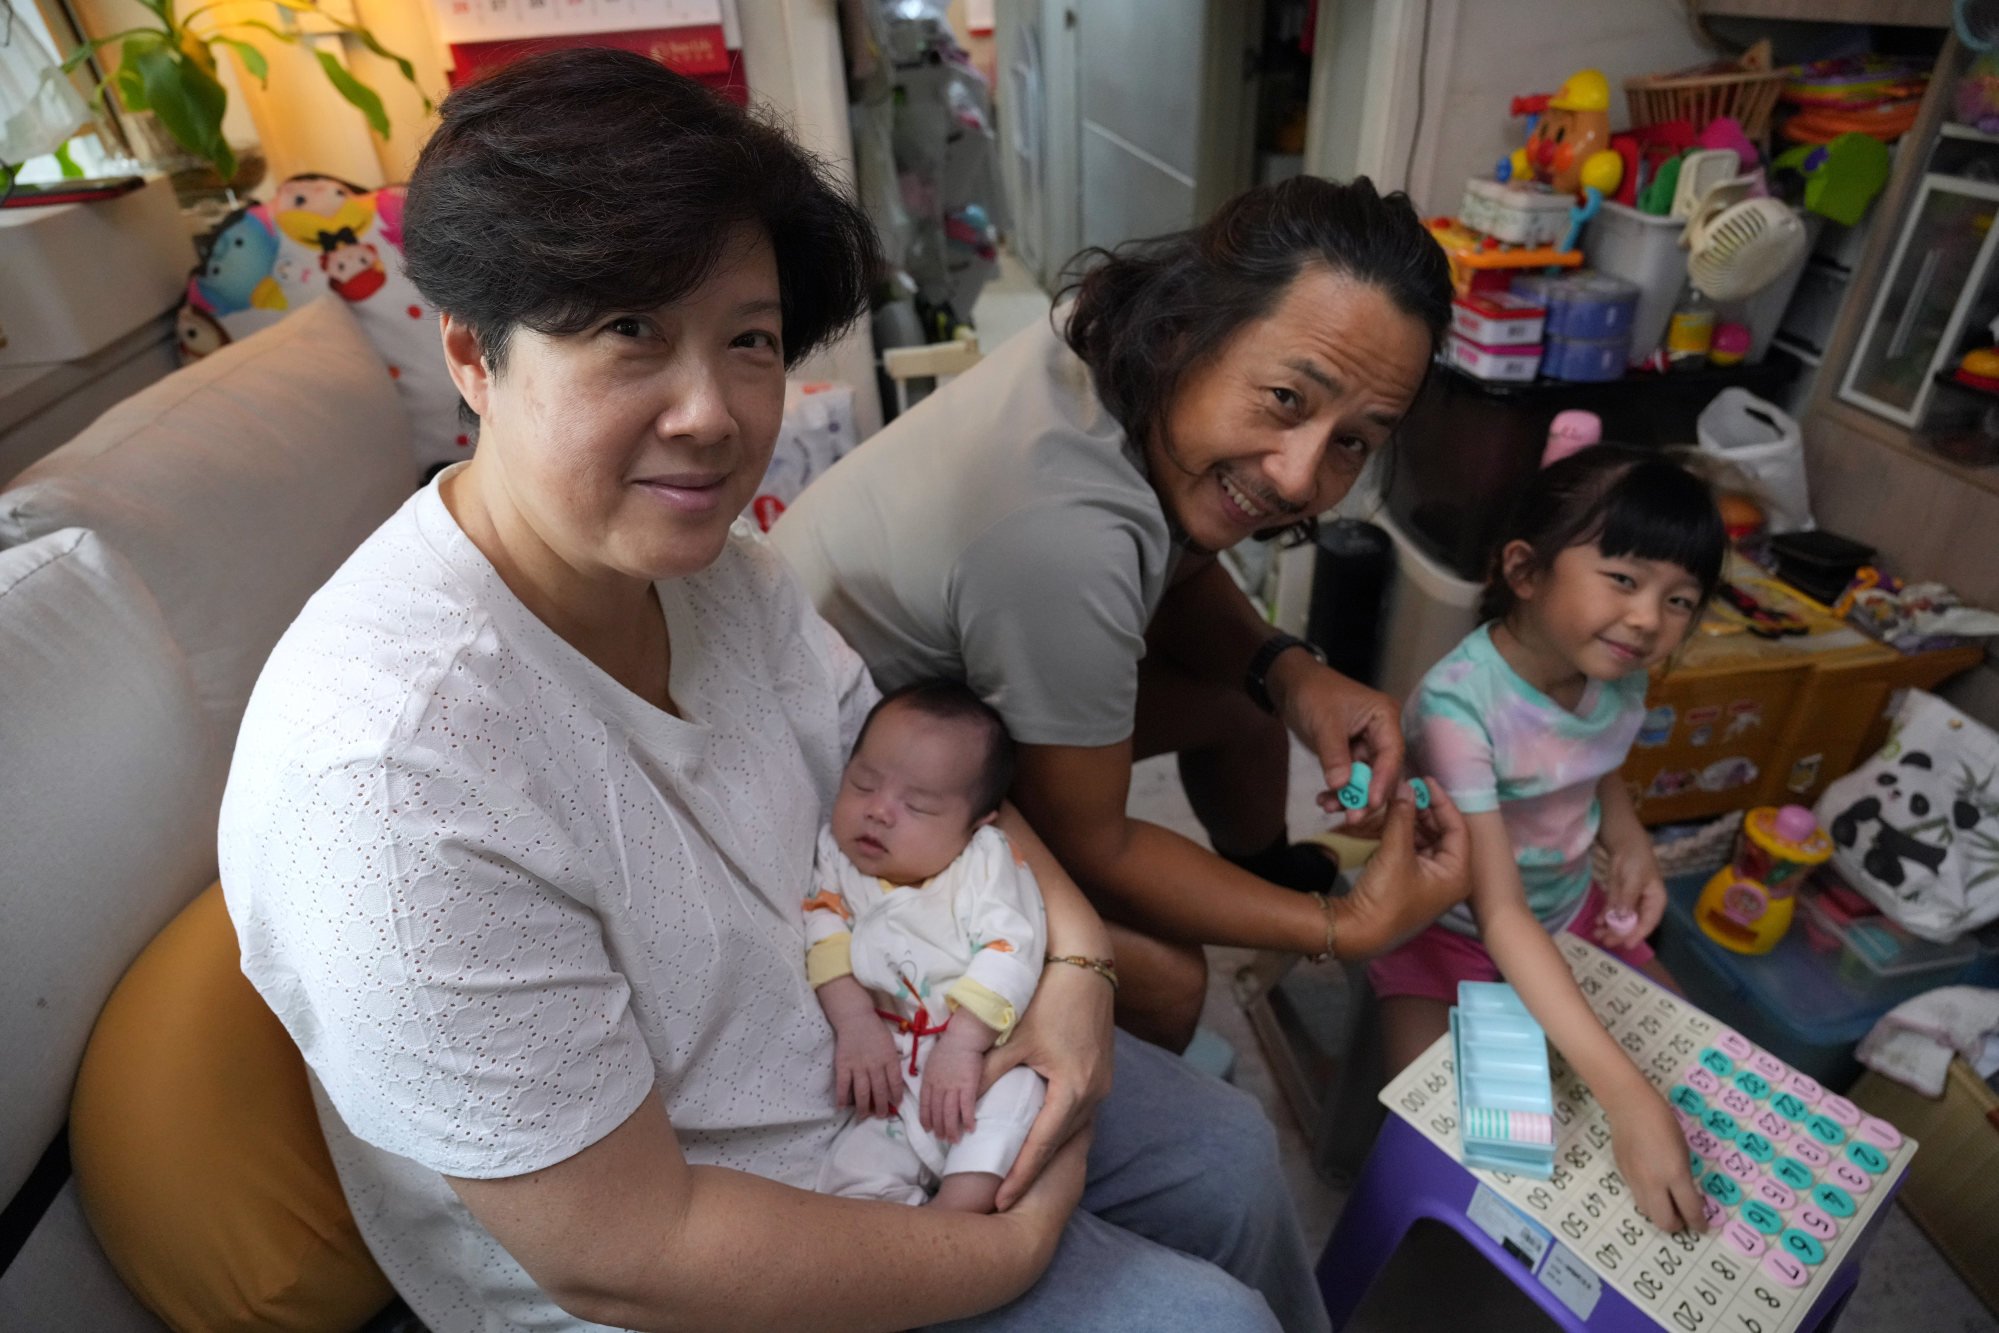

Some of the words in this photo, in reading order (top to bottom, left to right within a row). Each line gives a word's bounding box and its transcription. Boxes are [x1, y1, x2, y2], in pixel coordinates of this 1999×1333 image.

[1596, 960, 1618, 979] 81
[1624, 981, 1647, 998] 71
[1606, 997, 1632, 1015] 72
[1655, 998, 1677, 1019] 61
[1638, 1015, 1662, 1036] 62
[1684, 1017, 1710, 1036] 51
[1621, 1031, 1645, 1053] 63
[1669, 1034, 1694, 1055] 52
[1652, 1051, 1678, 1073] 53
[1704, 1051, 1729, 1072] 42
[1424, 1072, 1448, 1094] 99
[1689, 1067, 1714, 1089] 43
[1737, 1072, 1766, 1094] 32
[1401, 1088, 1431, 1113] 100
[1723, 1089, 1749, 1112] 33
[1775, 1094, 1803, 1119] 22
[1826, 1099, 1854, 1120] 11
[1431, 1114, 1456, 1135] 90
[1709, 1110, 1734, 1135] 34
[1759, 1112, 1787, 1135] 23
[1811, 1116, 1841, 1141] 12
[1870, 1125, 1894, 1142] 1
[1585, 1125, 1611, 1149] 57
[1743, 1132, 1769, 1158] 24
[1564, 1144, 1592, 1169] 58
[1796, 1137, 1825, 1161] 13
[1854, 1146, 1879, 1166] 2
[1725, 1152, 1753, 1177] 25
[1782, 1158, 1808, 1184] 14
[1838, 1166, 1863, 1185] 3
[1599, 1171, 1625, 1196] 48
[1708, 1174, 1735, 1201] 26
[1761, 1178, 1789, 1204] 15
[1527, 1187, 1552, 1211] 60
[1581, 1192, 1607, 1218] 49
[1821, 1190, 1845, 1209] 4
[1561, 1212, 1588, 1240] 50
[1748, 1202, 1776, 1228] 16
[1803, 1211, 1829, 1232] 5
[1616, 1218, 1643, 1246] 39
[1732, 1224, 1760, 1251] 17
[1595, 1243, 1623, 1270] 40
[1789, 1235, 1812, 1256] 6
[1654, 1246, 1682, 1276] 29
[1711, 1253, 1741, 1281] 18
[1774, 1259, 1799, 1280] 7
[1633, 1271, 1663, 1300] 30
[1694, 1277, 1723, 1306] 19
[1754, 1287, 1781, 1308] 8
[1673, 1301, 1703, 1332] 20
[1737, 1314, 1762, 1333] 9
